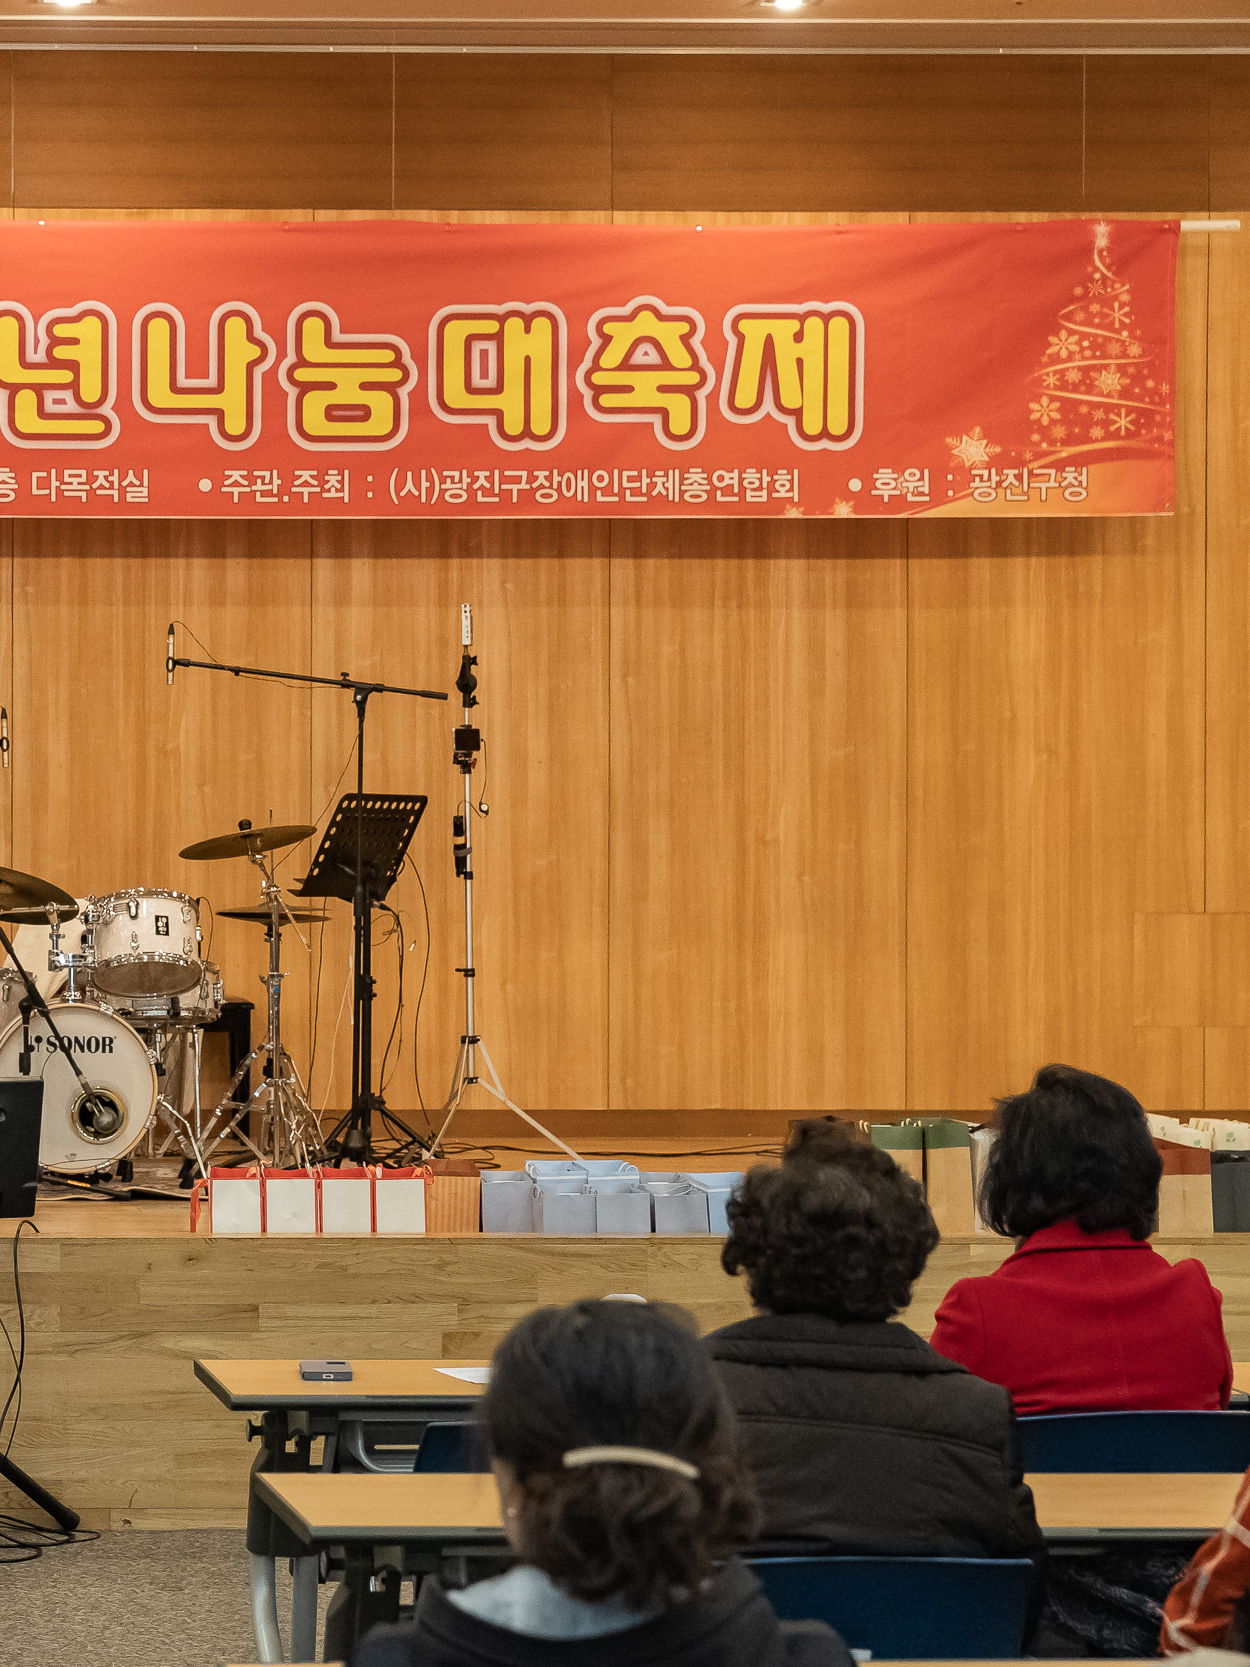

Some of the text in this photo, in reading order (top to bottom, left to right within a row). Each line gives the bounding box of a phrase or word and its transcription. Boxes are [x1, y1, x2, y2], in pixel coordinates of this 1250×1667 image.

[31, 469, 149, 503] 다목적실
[221, 470, 349, 503] 주관.주최
[389, 468, 799, 505] (사)광진구장애인단체총연합회
[871, 469, 930, 503] 후원
[969, 468, 1089, 502] 광진구청
[45, 1034, 114, 1055] SONOR
